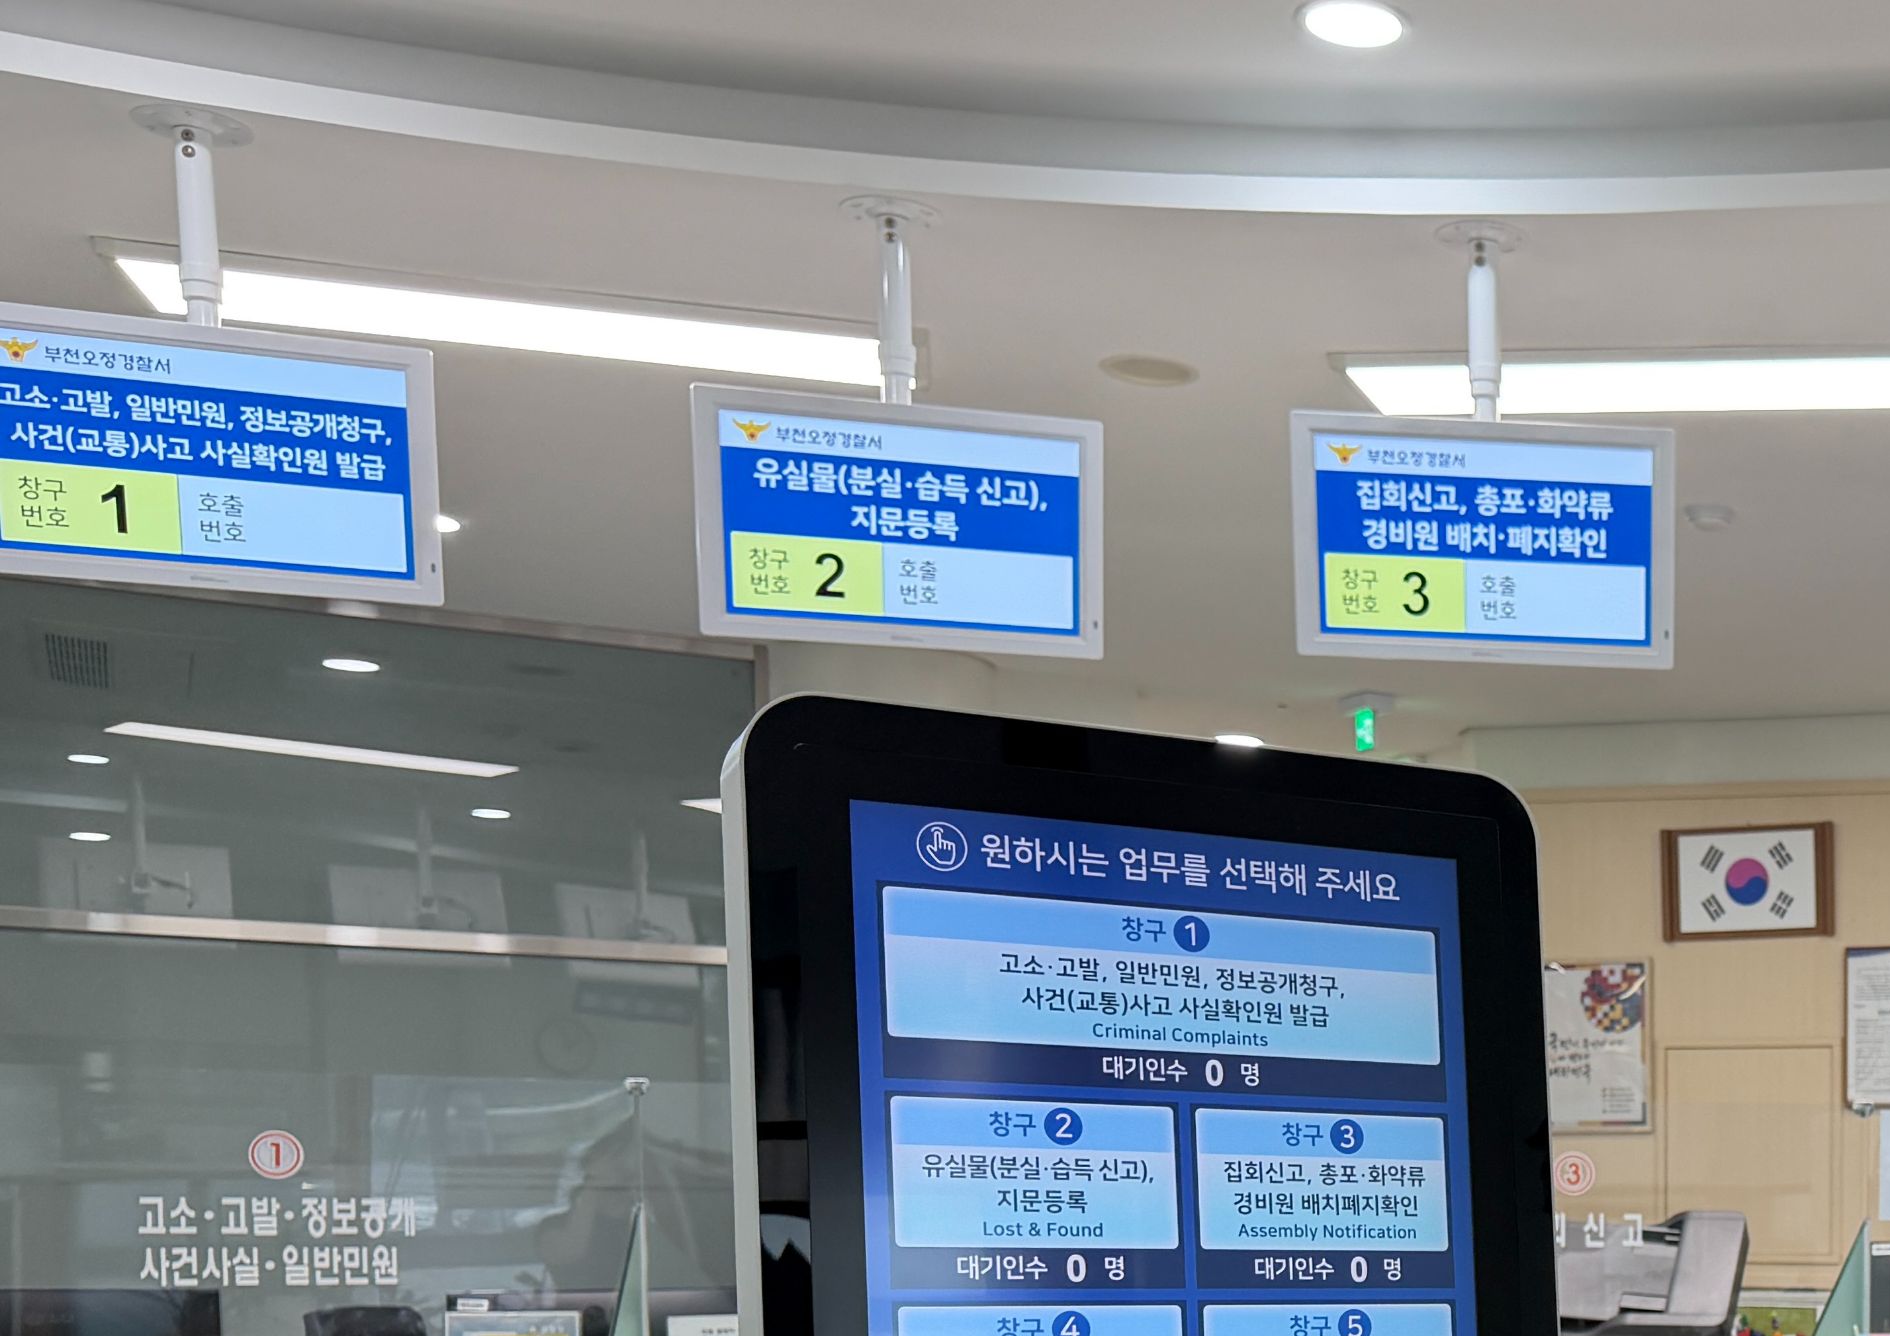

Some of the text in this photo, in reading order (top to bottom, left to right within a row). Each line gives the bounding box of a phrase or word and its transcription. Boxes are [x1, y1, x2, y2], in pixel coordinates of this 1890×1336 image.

[45, 345, 171, 374] 부천오정경찰서
[130, 394, 234, 430] 일반민원,
[240, 406, 392, 446] 정보공개청구,
[11, 421, 386, 481] 사건(교통)사고 사실확인원 발급
[18, 475, 67, 501] 창구
[753, 457, 1048, 512] 유실물(분실·습득 신고),
[101, 484, 128, 534] 1
[199, 492, 244, 517] 호출
[1356, 480, 1614, 521] 집회신고, 총포·화약류
[22, 505, 69, 529] 번호
[199, 519, 246, 543] 번호
[851, 505, 958, 541] 지문등록
[1363, 520, 1607, 559] 경비원 배치·폐지확인
[815, 553, 845, 598] 2
[1403, 571, 1429, 616] 3
[980, 833, 1400, 902] 원하시는 업무를 선택해 주세요
[1121, 917, 1167, 943] 창구
[999, 953, 1345, 999] 고소·고발, 일반민원, 정보공개청구,
[1022, 986, 1329, 1028] 사건(교통)사고 사실확인원 발급
[1092, 1022, 1268, 1050] Criminal Complaints
[1102, 1055, 1260, 1087] 대기인수 0 명
[989, 1112, 1036, 1137] 창구
[922, 1154, 1154, 1184] 유실물(분실·습득 신고),
[1224, 1161, 1425, 1187] 집회신고, 총포·화약류
[998, 1189, 1088, 1213] 지문등록
[1234, 1192, 1418, 1217] 경비원 배치폐지확인
[983, 1222, 1103, 1237] Lost & Found
[1239, 1224, 1416, 1241] Assembly Notification
